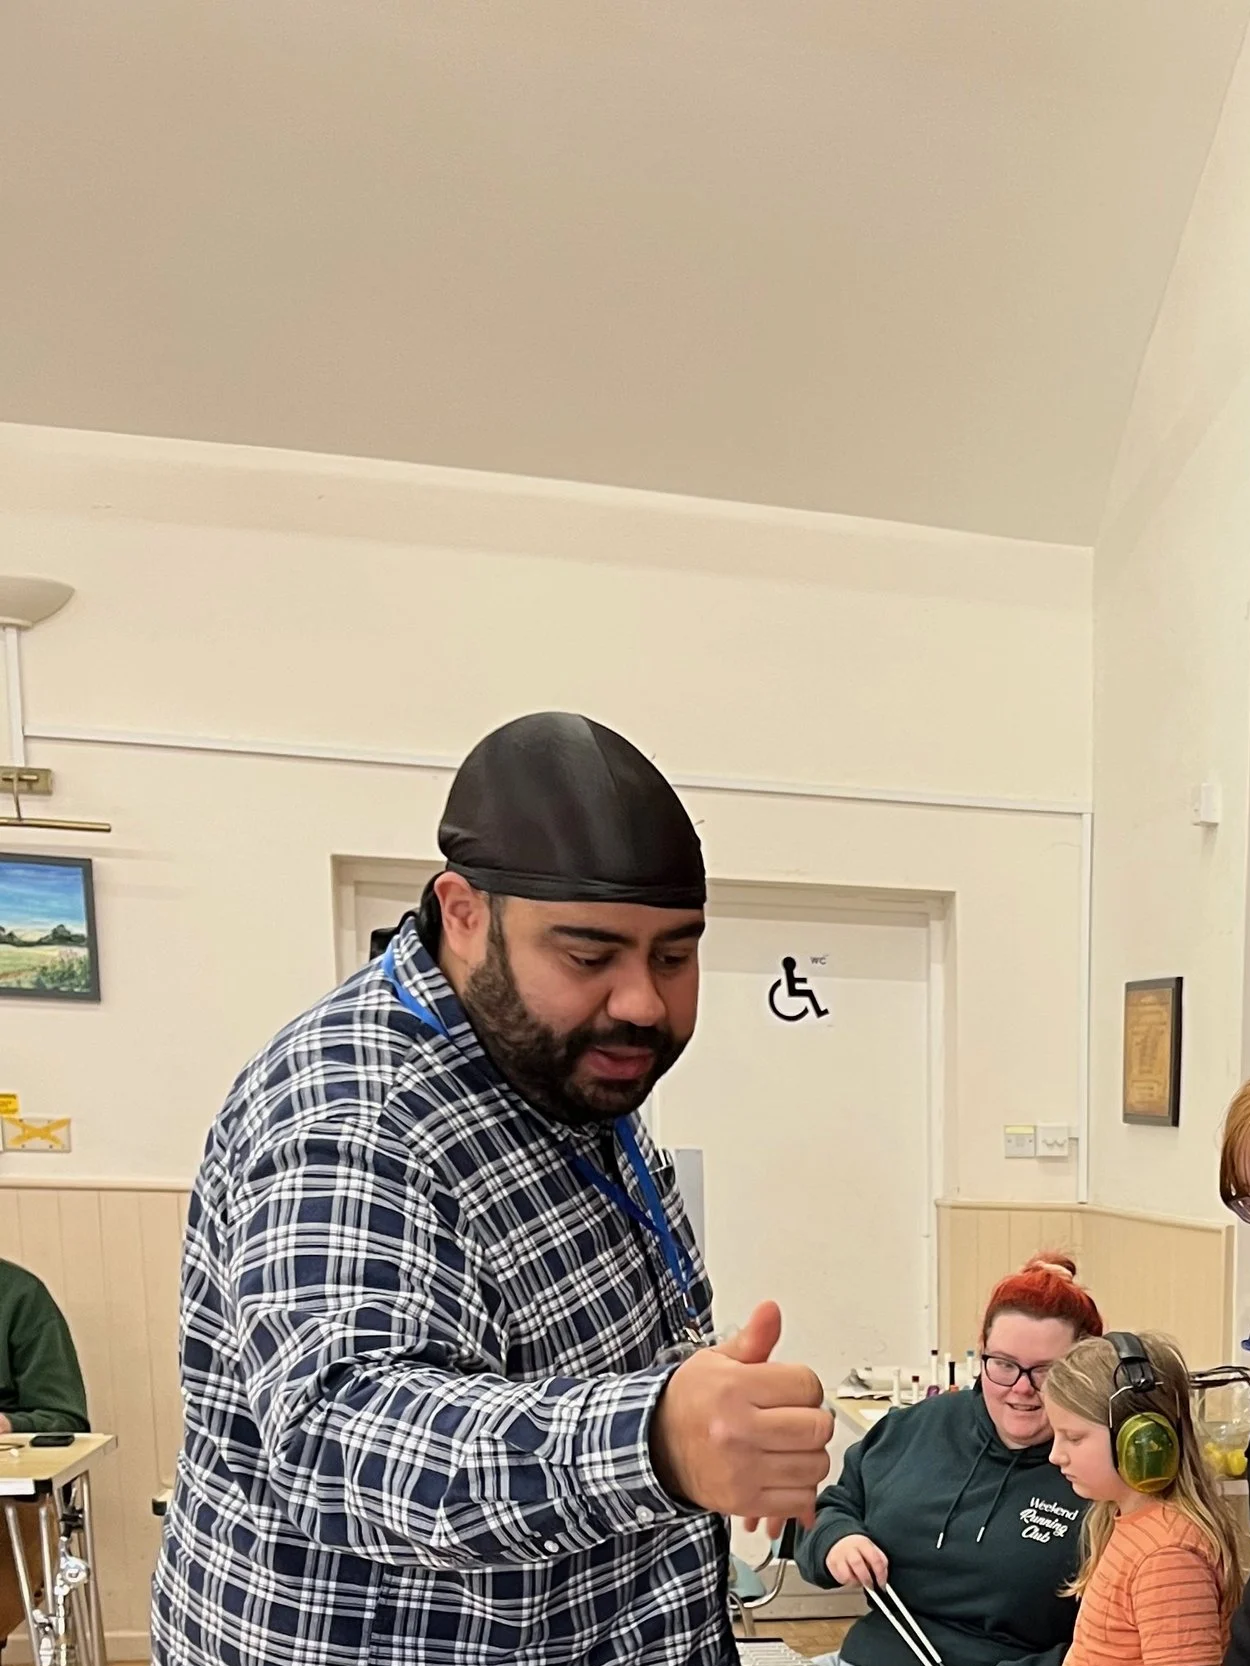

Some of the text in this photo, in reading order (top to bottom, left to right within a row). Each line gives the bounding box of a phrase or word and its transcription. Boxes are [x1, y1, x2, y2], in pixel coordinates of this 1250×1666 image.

[810, 956, 827, 966] WC
[1030, 1496, 1079, 1521] Weekend
[1019, 1508, 1068, 1537] Running
[1021, 1524, 1051, 1543] Club
